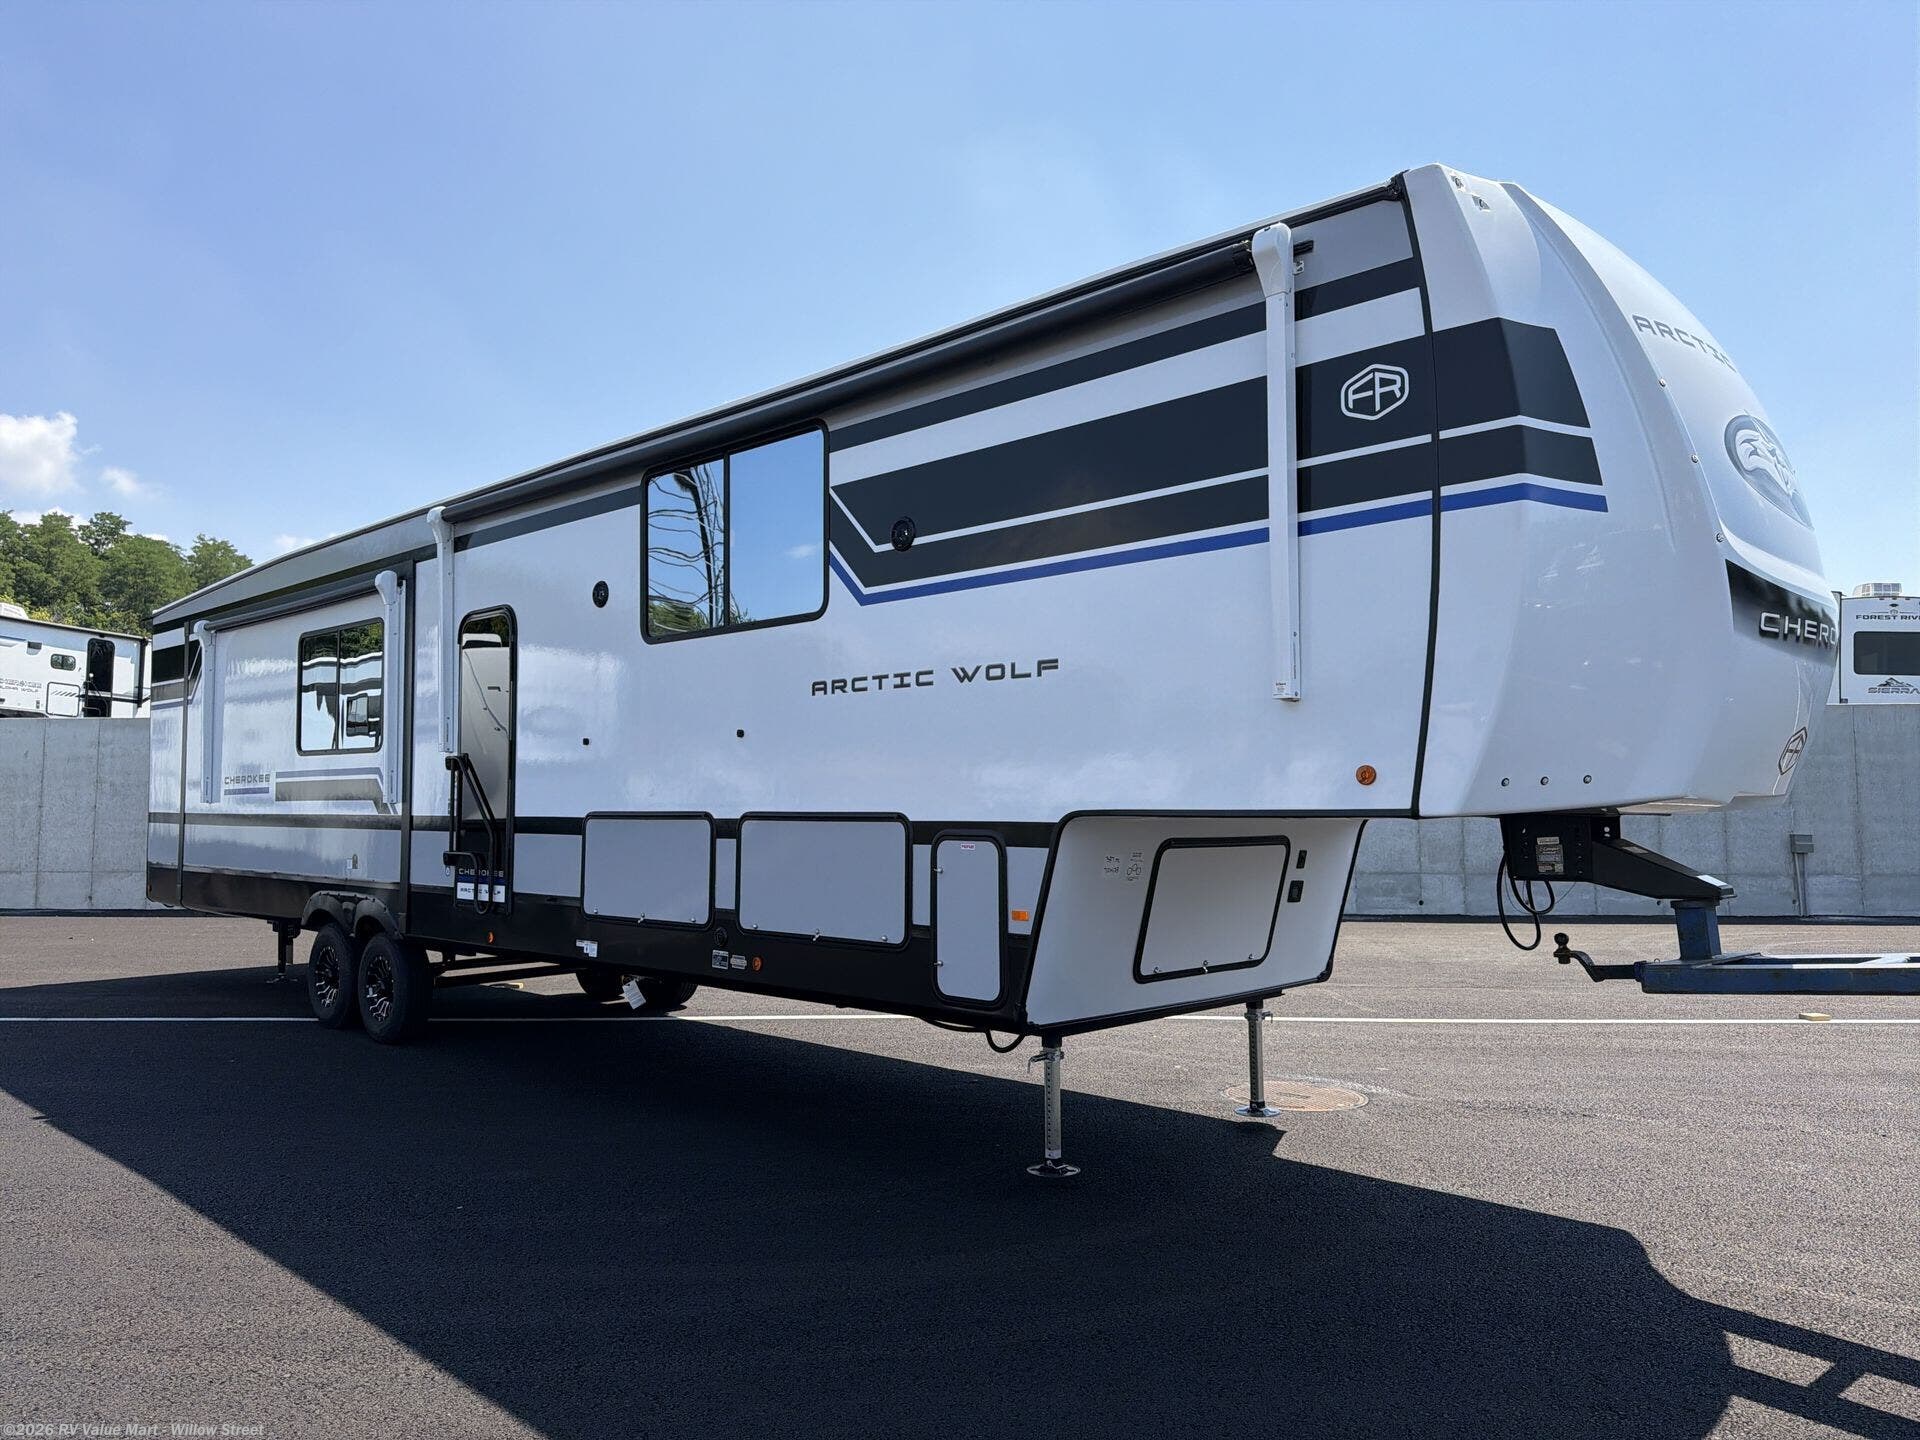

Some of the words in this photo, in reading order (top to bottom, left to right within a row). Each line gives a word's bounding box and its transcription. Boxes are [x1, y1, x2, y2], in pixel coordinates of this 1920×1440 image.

[811, 669, 934, 696] ARCTIC
[950, 658, 1059, 683] WOLF
[224, 773, 270, 785] CHEROKEE
